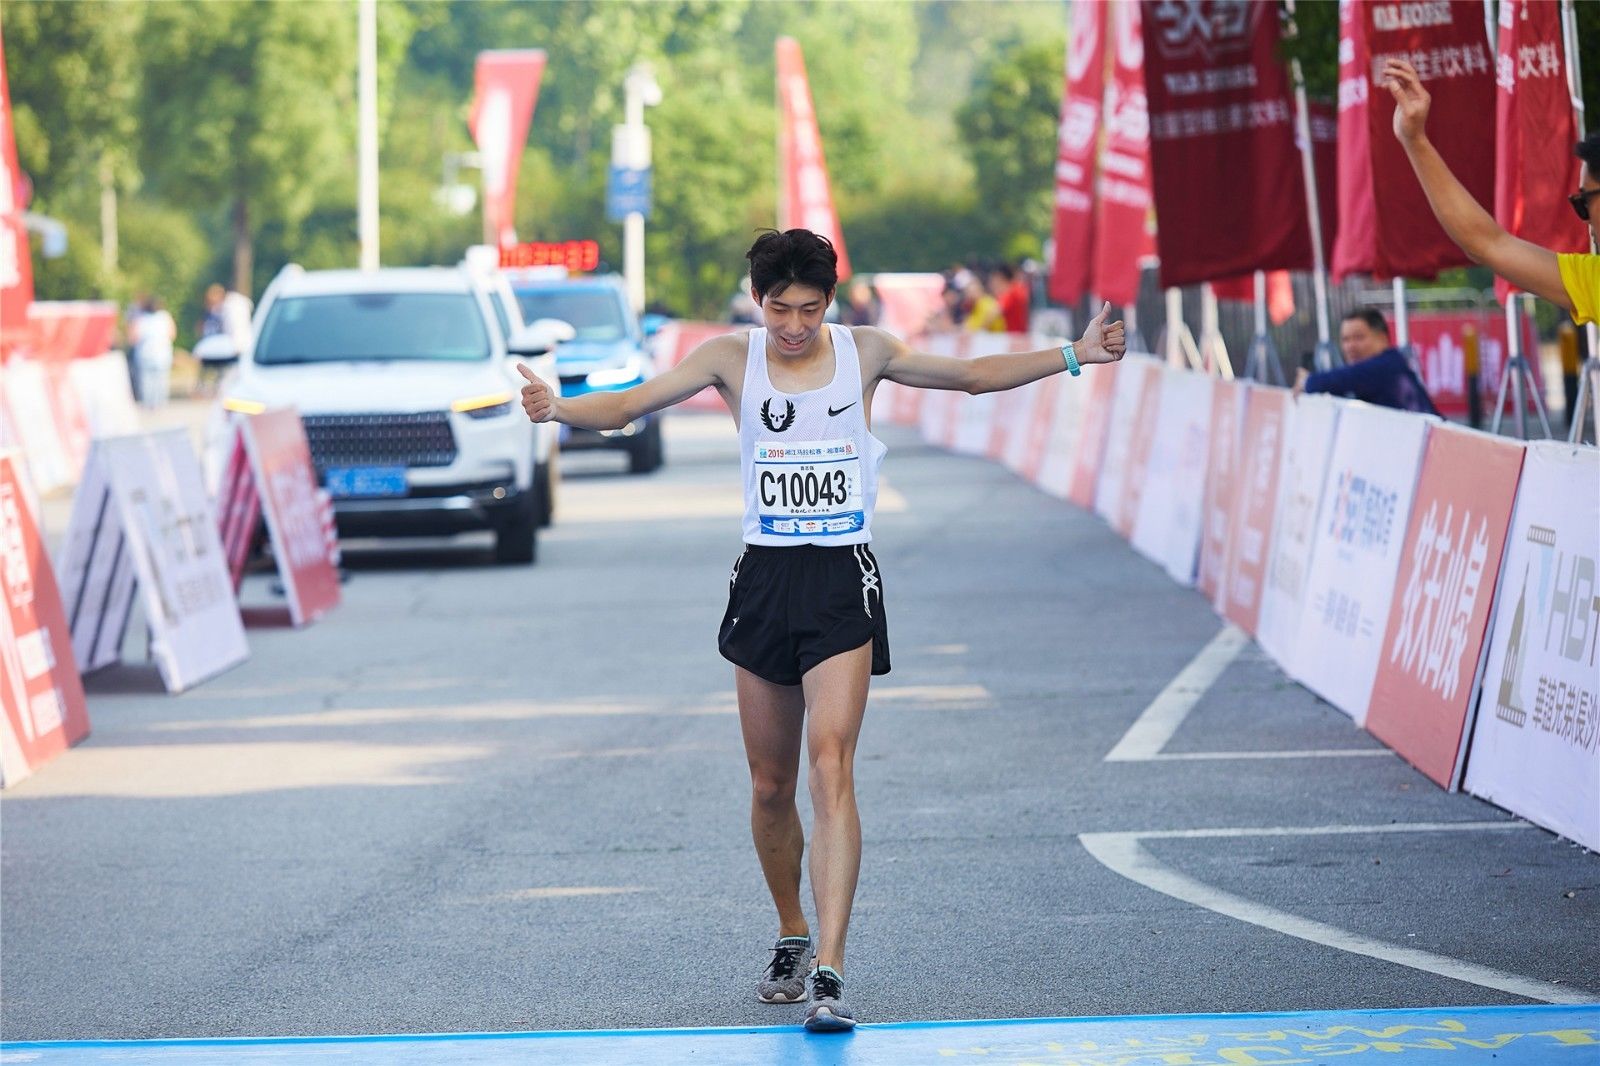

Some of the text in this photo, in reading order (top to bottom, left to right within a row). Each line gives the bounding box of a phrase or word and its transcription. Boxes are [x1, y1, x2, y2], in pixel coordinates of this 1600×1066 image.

[768, 449, 784, 458] 2019
[760, 470, 847, 507] C10043
[1390, 498, 1488, 702] 农夫山泉
